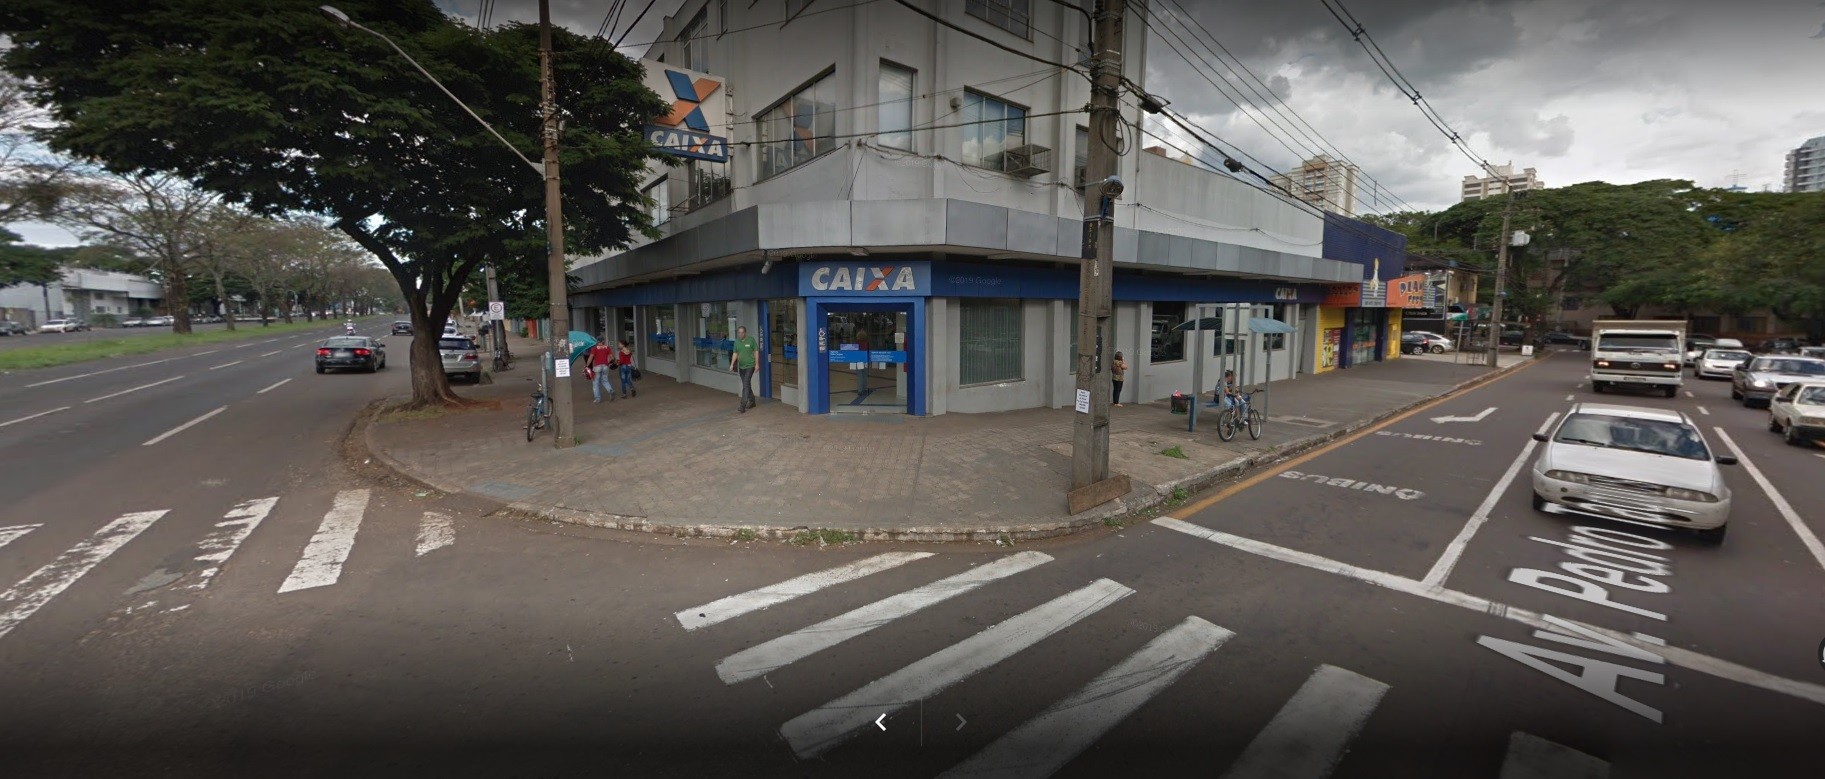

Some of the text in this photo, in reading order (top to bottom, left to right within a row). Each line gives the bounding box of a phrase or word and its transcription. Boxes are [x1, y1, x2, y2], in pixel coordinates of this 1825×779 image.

[650, 130, 724, 157] CAIXA
[811, 265, 916, 292] CAIXA
[1275, 287, 1298, 300] CAIXA
